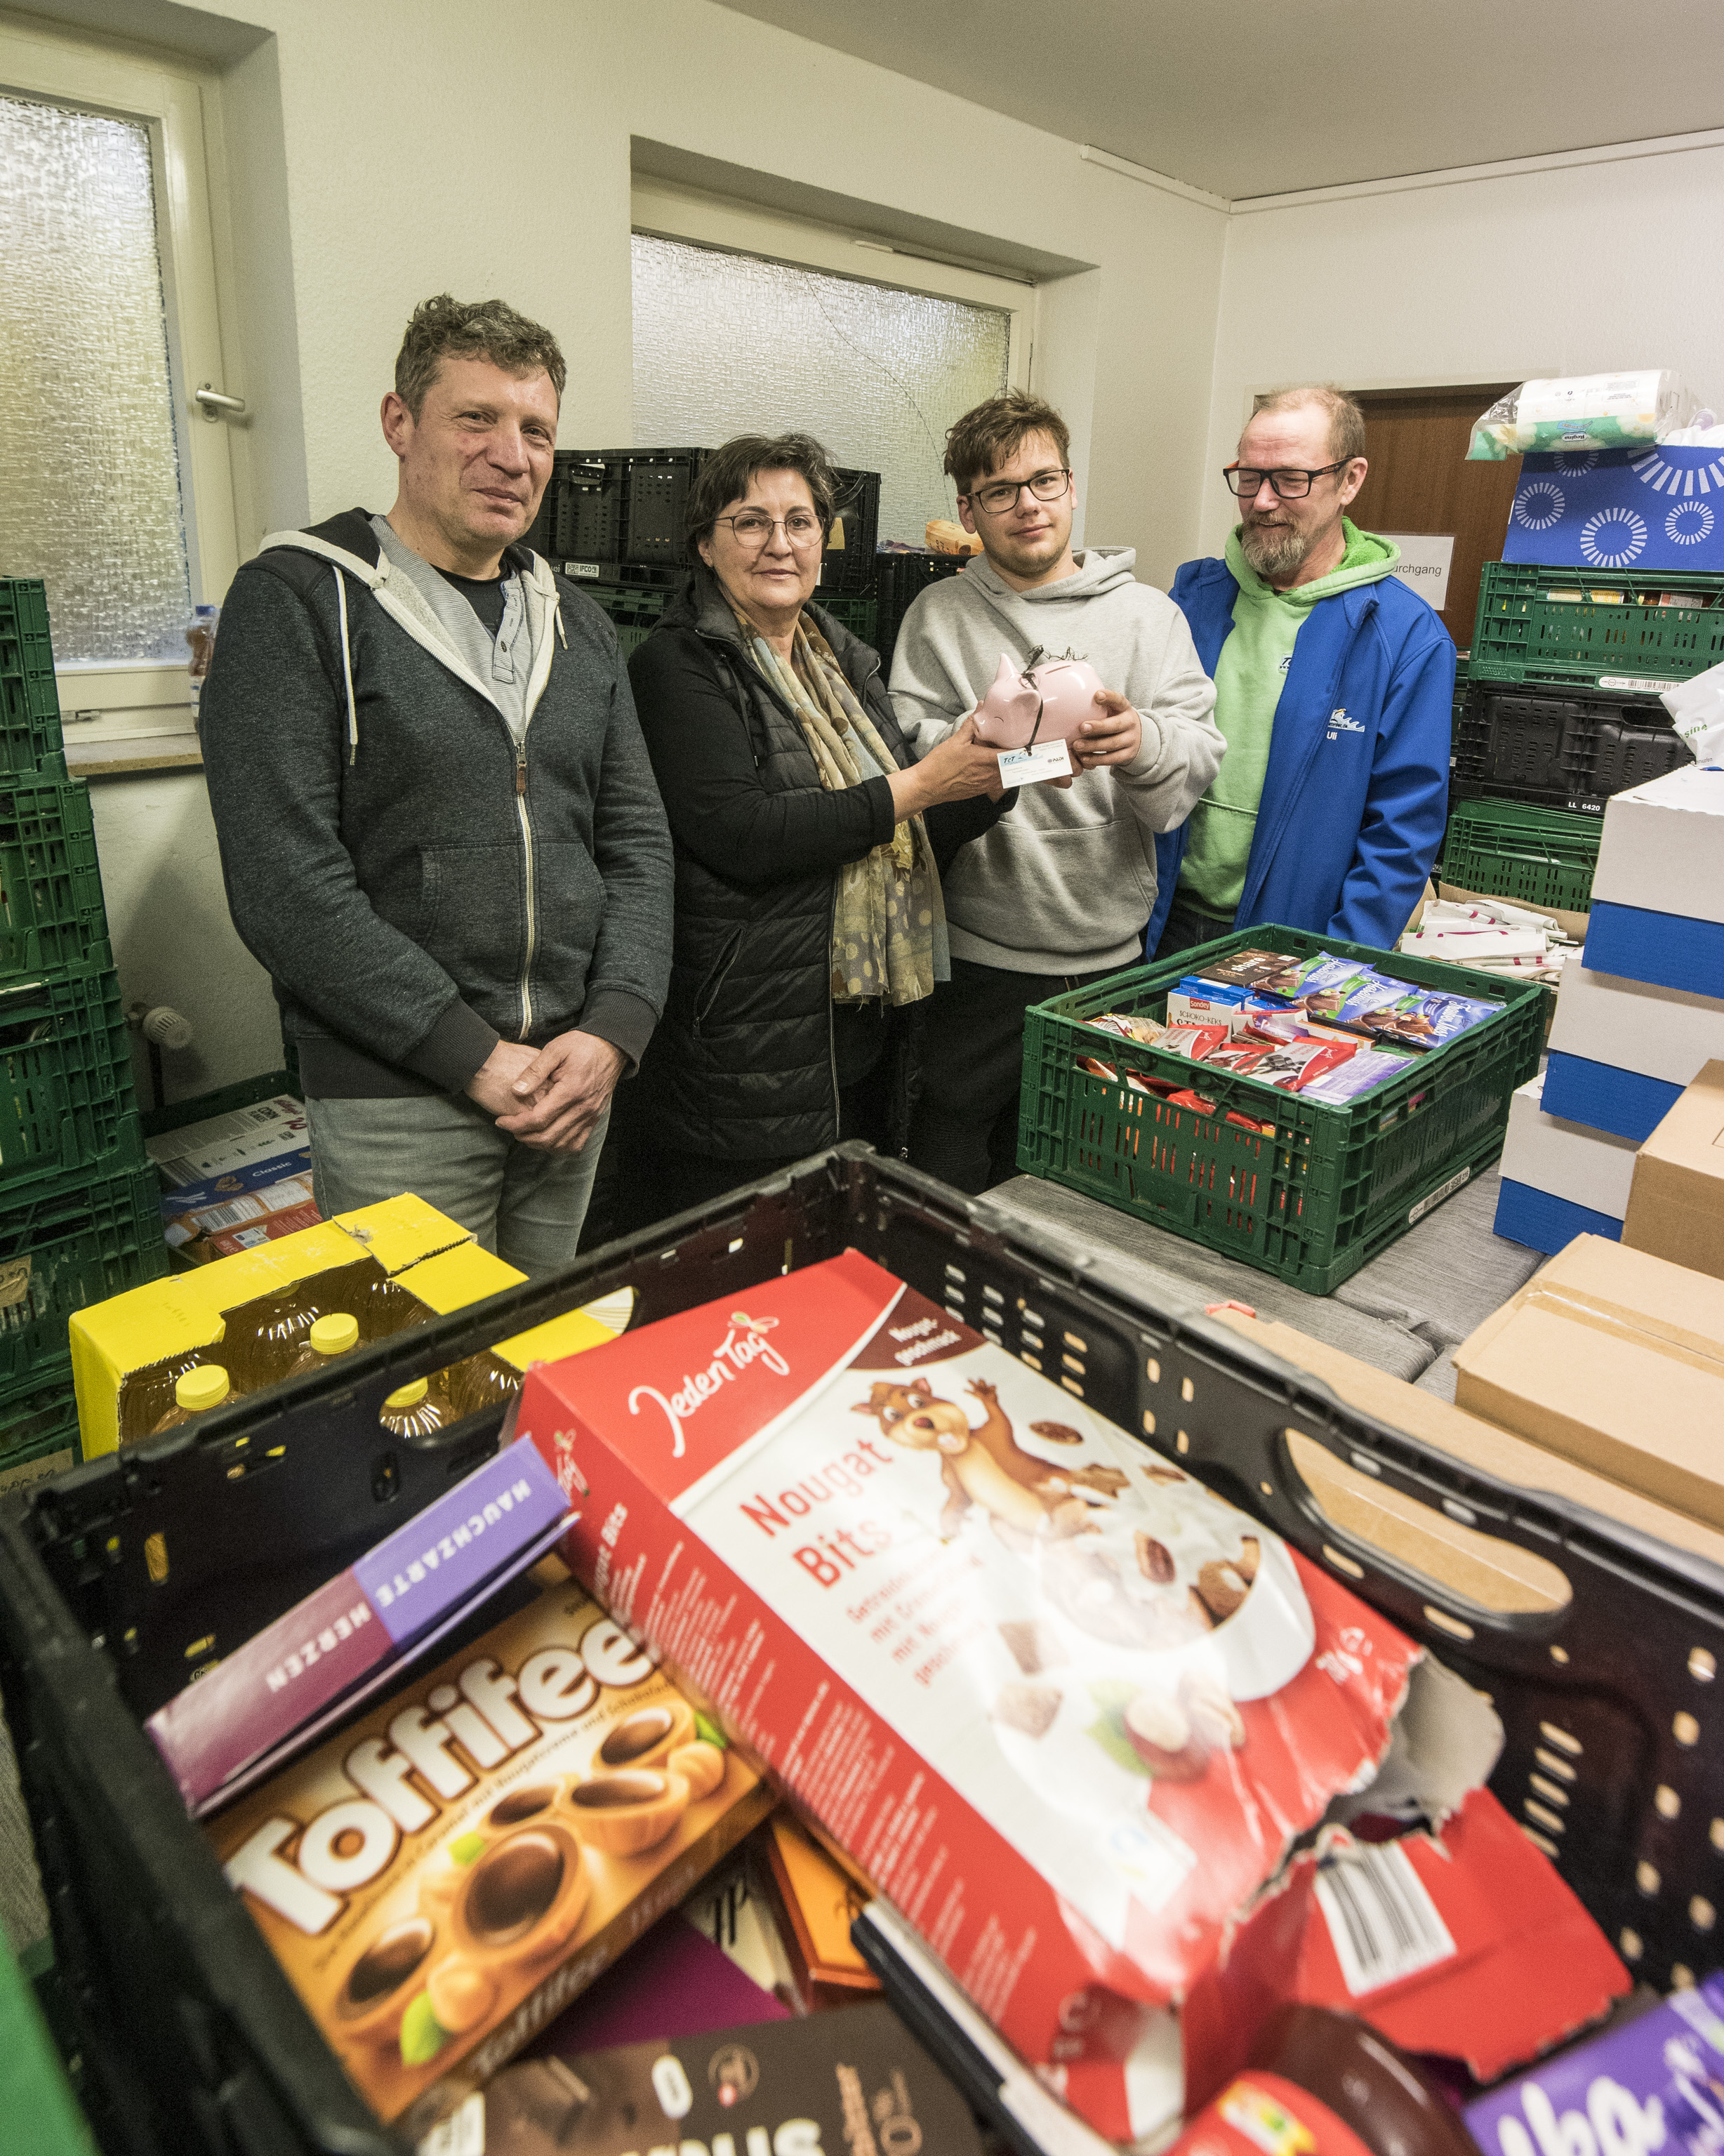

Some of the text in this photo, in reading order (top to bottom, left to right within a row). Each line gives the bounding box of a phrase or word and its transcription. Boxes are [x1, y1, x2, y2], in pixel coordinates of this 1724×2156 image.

[579, 564, 592, 573] IFCO
[1326, 731, 1338, 741] Uli
[1582, 803, 1601, 812] 6420
[1231, 957, 1266, 972] share
[1189, 1000, 1210, 1010] Sondey
[1179, 1010, 1223, 1026] SCHOKO-KEKS
[252, 1162, 293, 1177] Classic
[628, 1327, 790, 1459] Jeden Tag
[739, 1438, 895, 1540] Nougat
[375, 1478, 532, 1608] HAUCHZARTE
[791, 1520, 894, 1589] Bits
[265, 1601, 372, 1693] HERZEN
[223, 1617, 653, 1936] Toffifee
